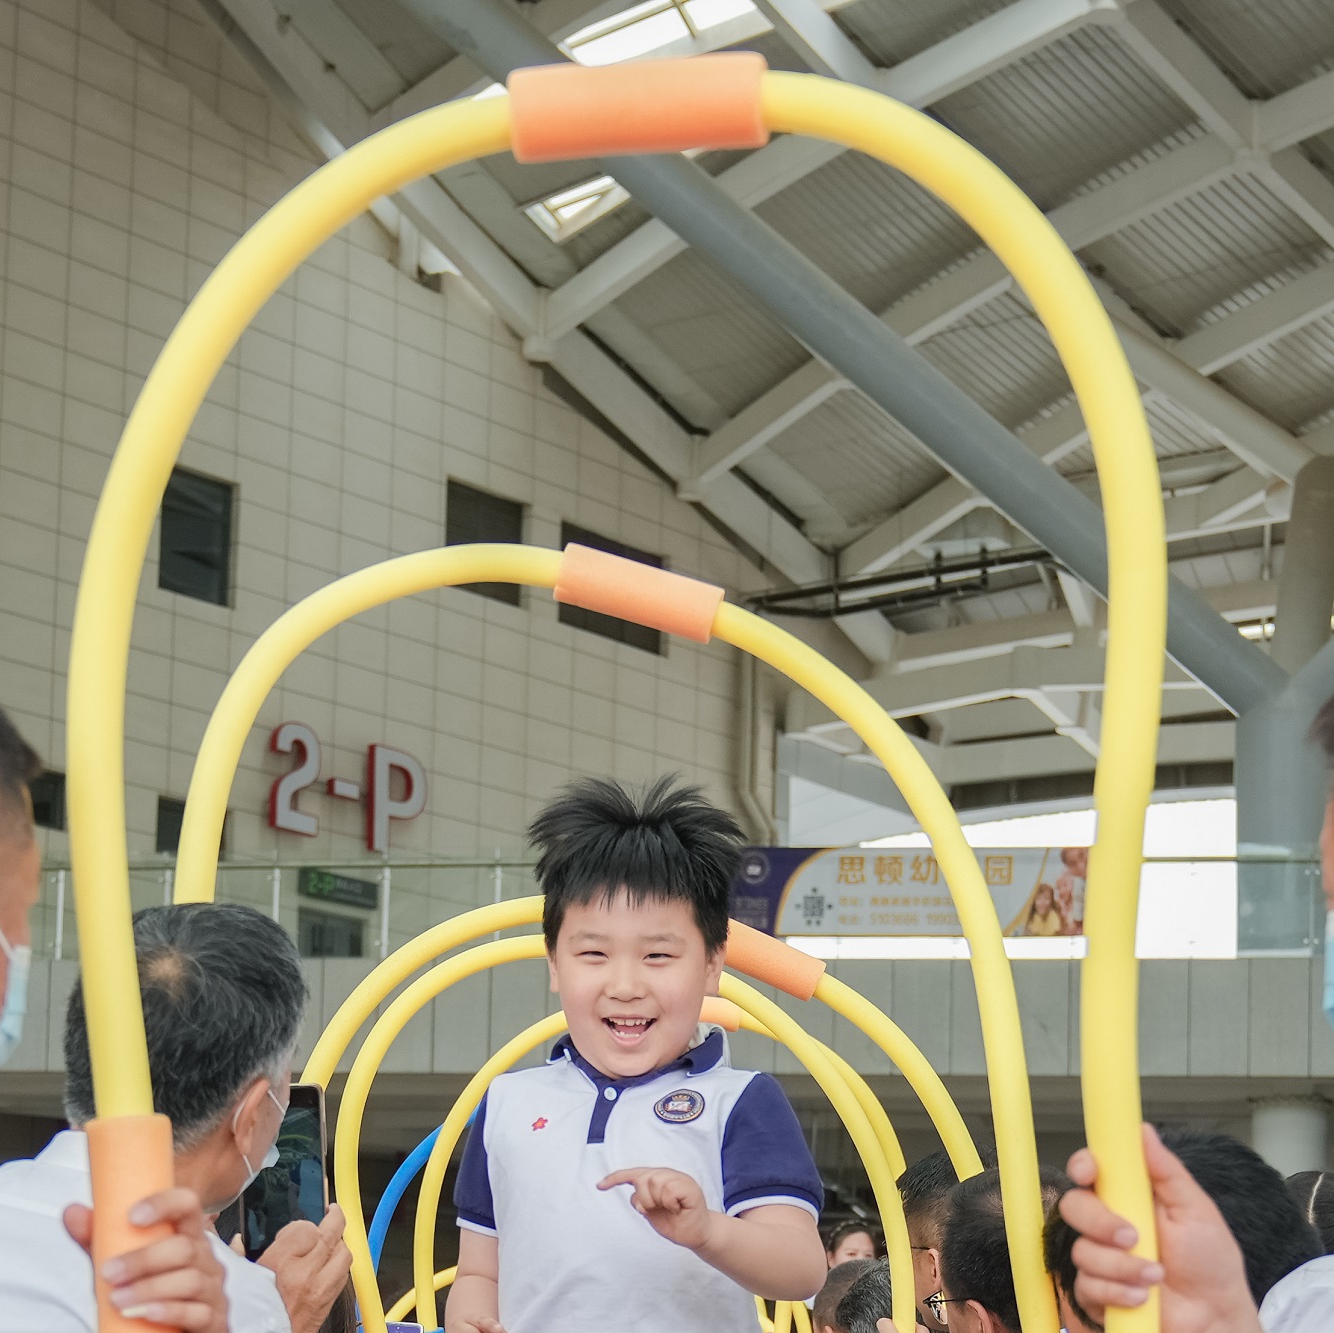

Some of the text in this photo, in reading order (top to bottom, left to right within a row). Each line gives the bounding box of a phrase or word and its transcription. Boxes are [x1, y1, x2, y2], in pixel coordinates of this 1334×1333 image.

[269, 721, 427, 851] 2-P
[837, 855, 1013, 885] 思顿幼园
